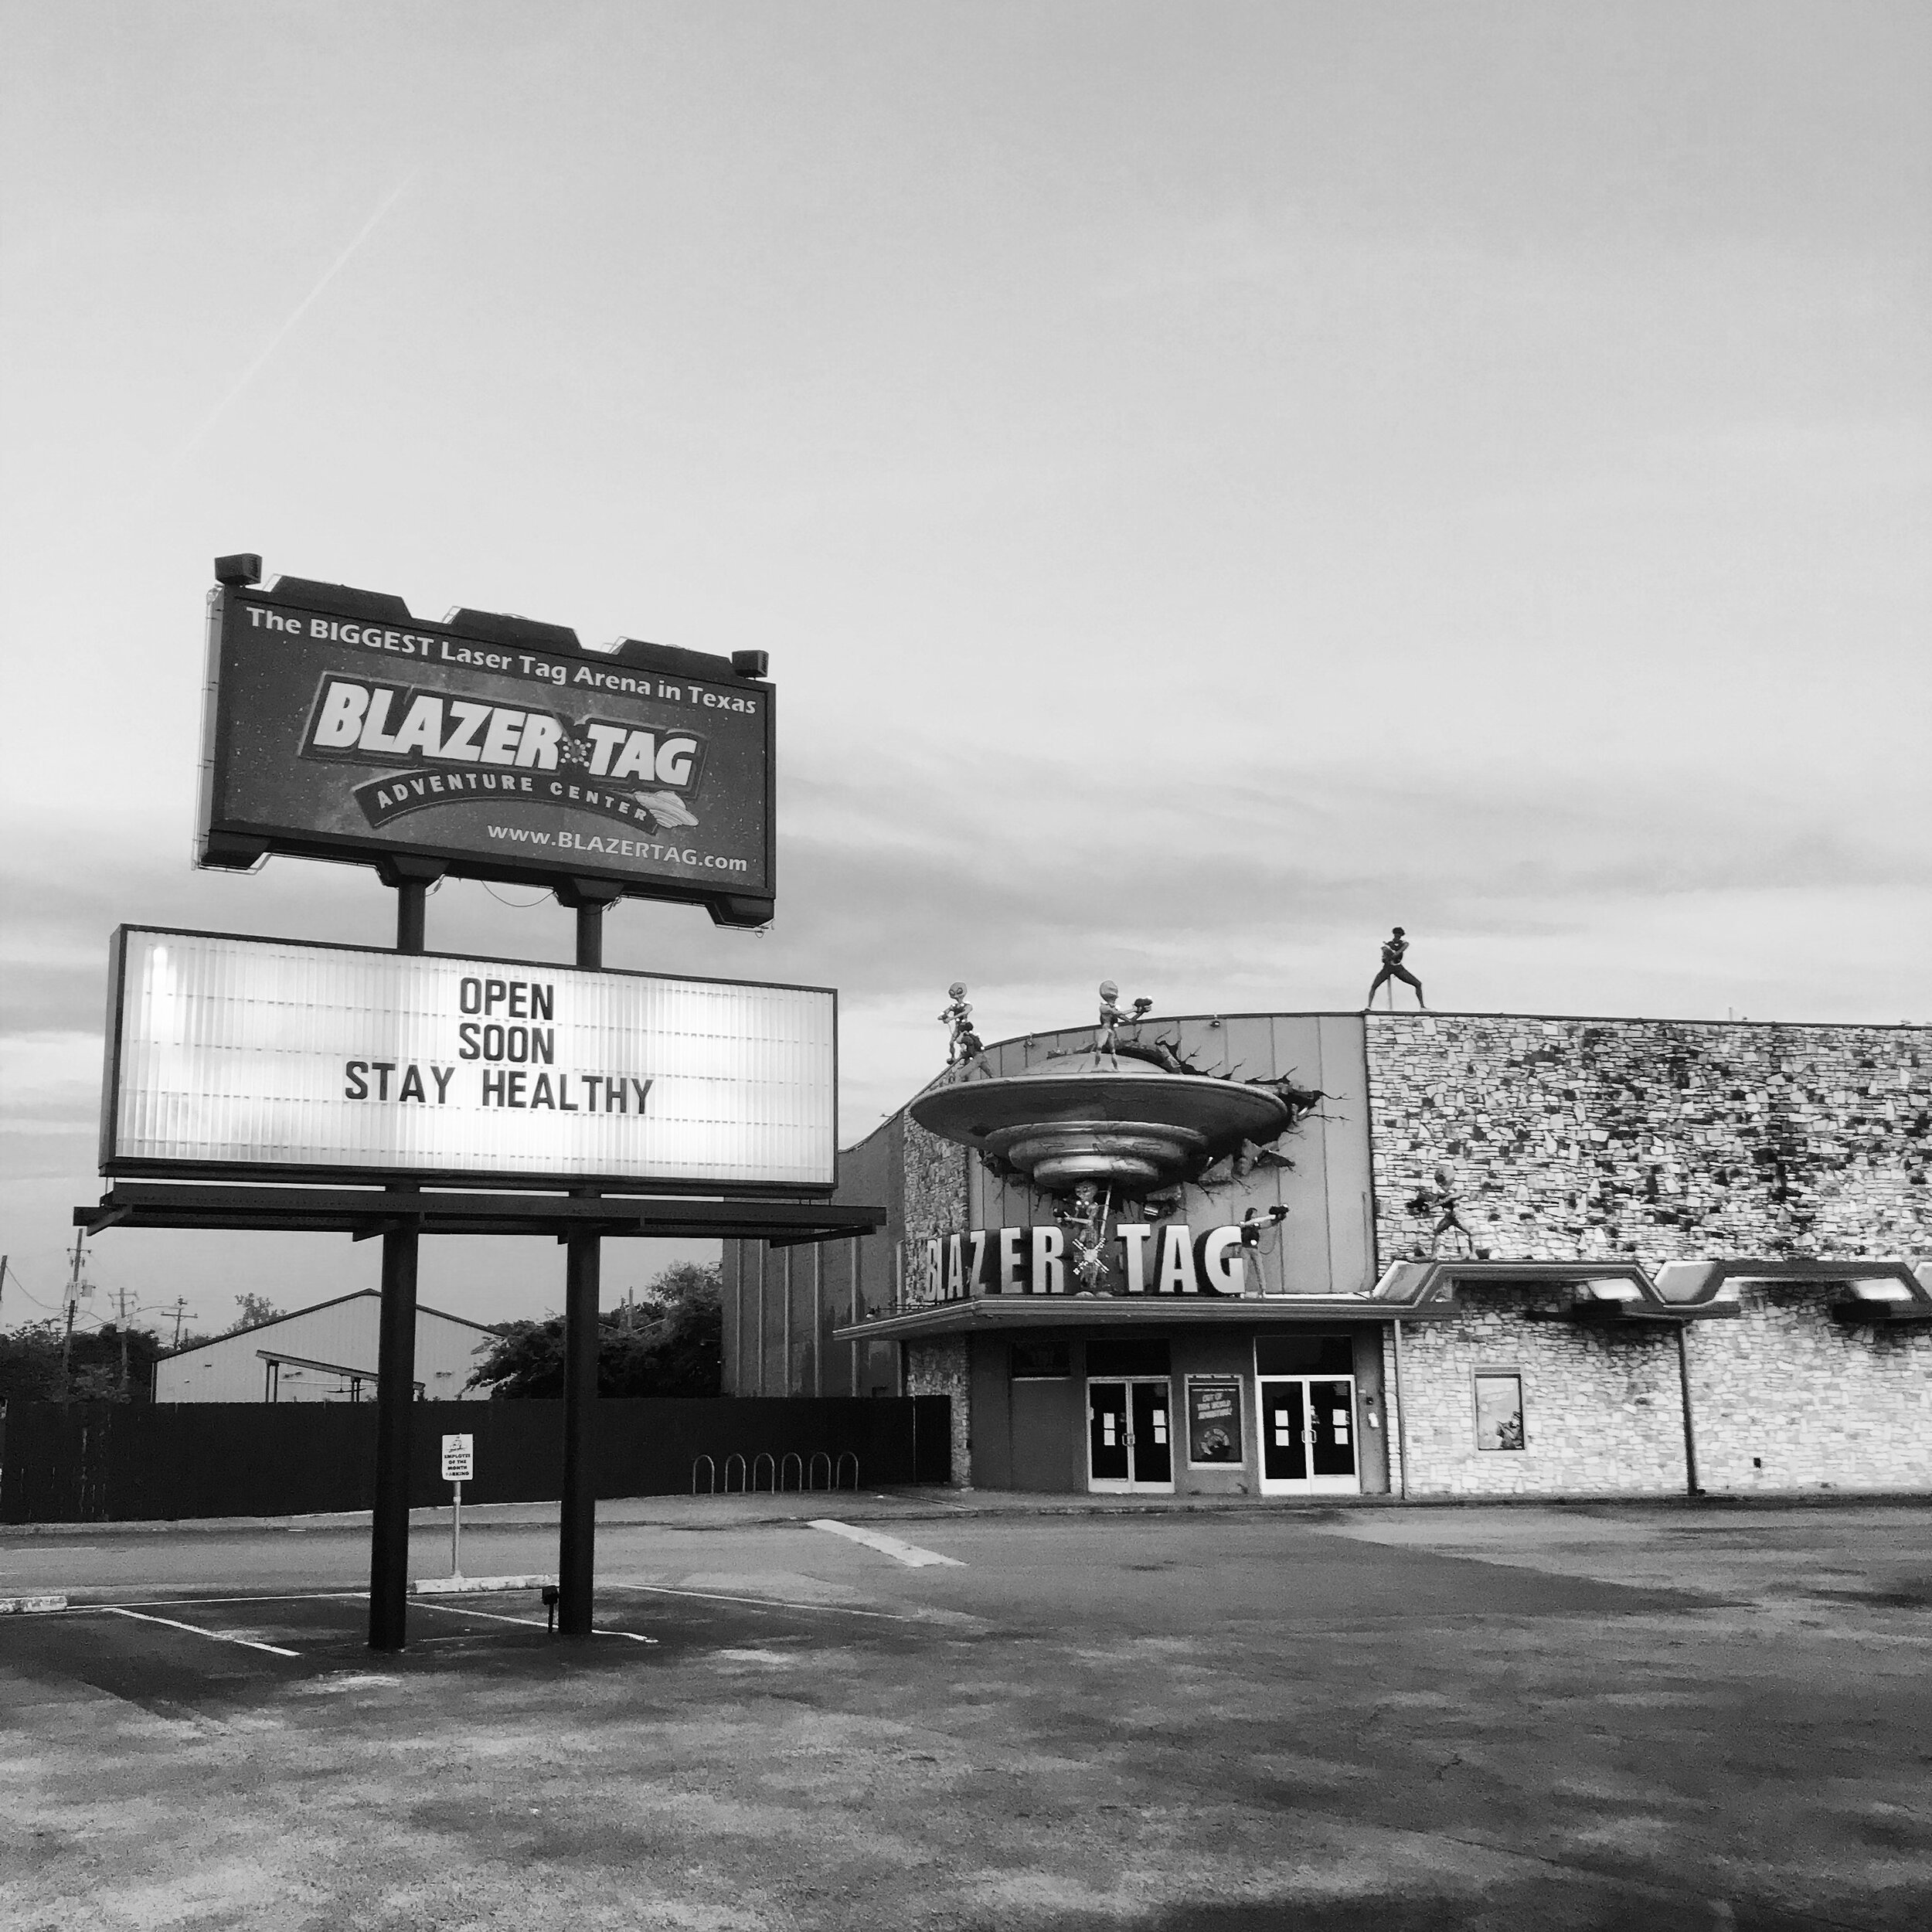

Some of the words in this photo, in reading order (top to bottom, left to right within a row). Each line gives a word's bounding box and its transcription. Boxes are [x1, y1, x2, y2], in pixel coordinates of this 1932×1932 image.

[246, 607, 301, 634] The
[310, 618, 434, 655] BIGGEST
[441, 641, 512, 670] Laser
[519, 655, 566, 685] Tag
[573, 666, 651, 695] Arena
[658, 680, 681, 700] in
[687, 685, 756, 714] Texas
[312, 681, 563, 770] BLAZER
[587, 723, 697, 786] TAG
[376, 773, 534, 809] ADVENTURE
[549, 782, 648, 821] CENTER
[487, 824, 748, 872] www.BLAZERTAG.com
[459, 977, 554, 1021] OPEN
[459, 1023, 554, 1065] SOON
[345, 1061, 456, 1104] STAY
[482, 1069, 653, 1114] HEALTHY
[924, 1226, 1064, 1301] BLAZER
[1117, 1224, 1245, 1293] TAG
